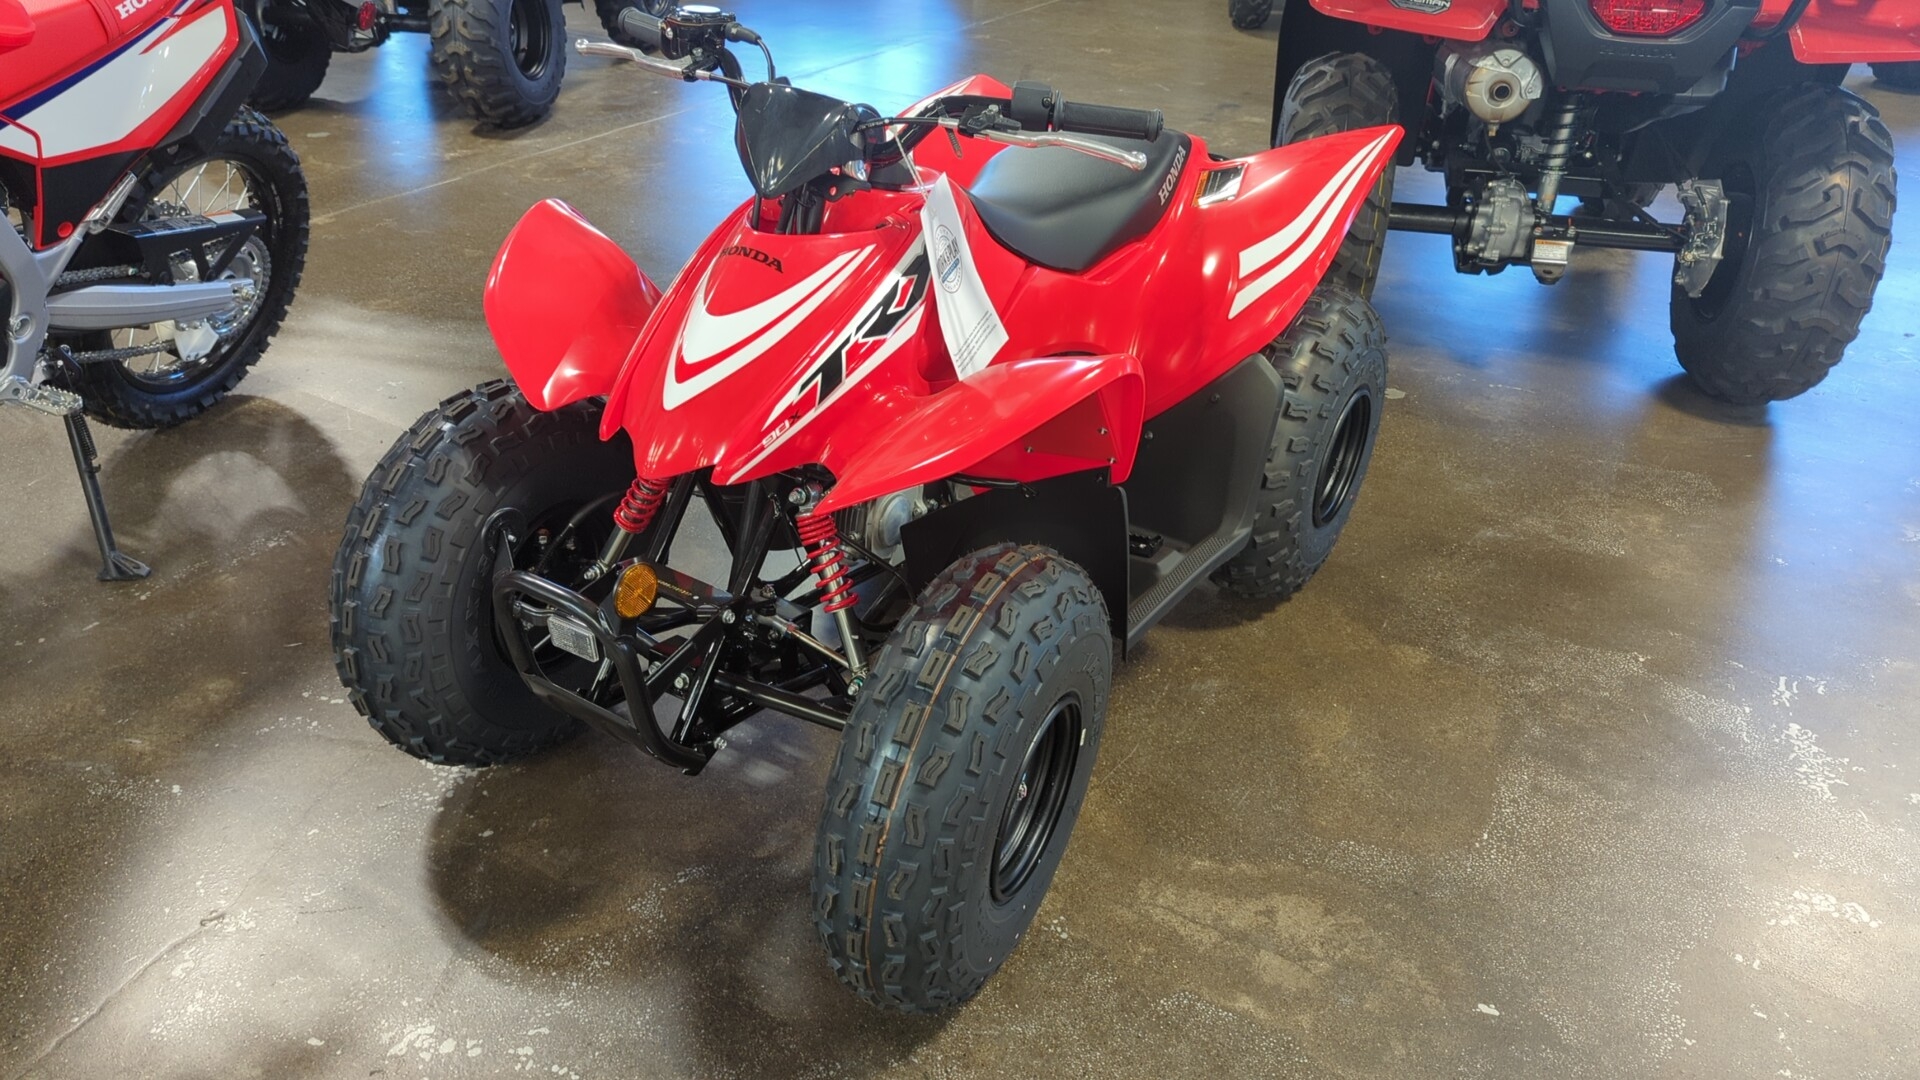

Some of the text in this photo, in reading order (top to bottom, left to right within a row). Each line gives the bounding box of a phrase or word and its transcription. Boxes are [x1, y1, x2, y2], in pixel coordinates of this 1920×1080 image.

[115, 0, 152, 20] HO
[1158, 144, 1187, 206] HONDA
[719, 245, 784, 274] HONDA
